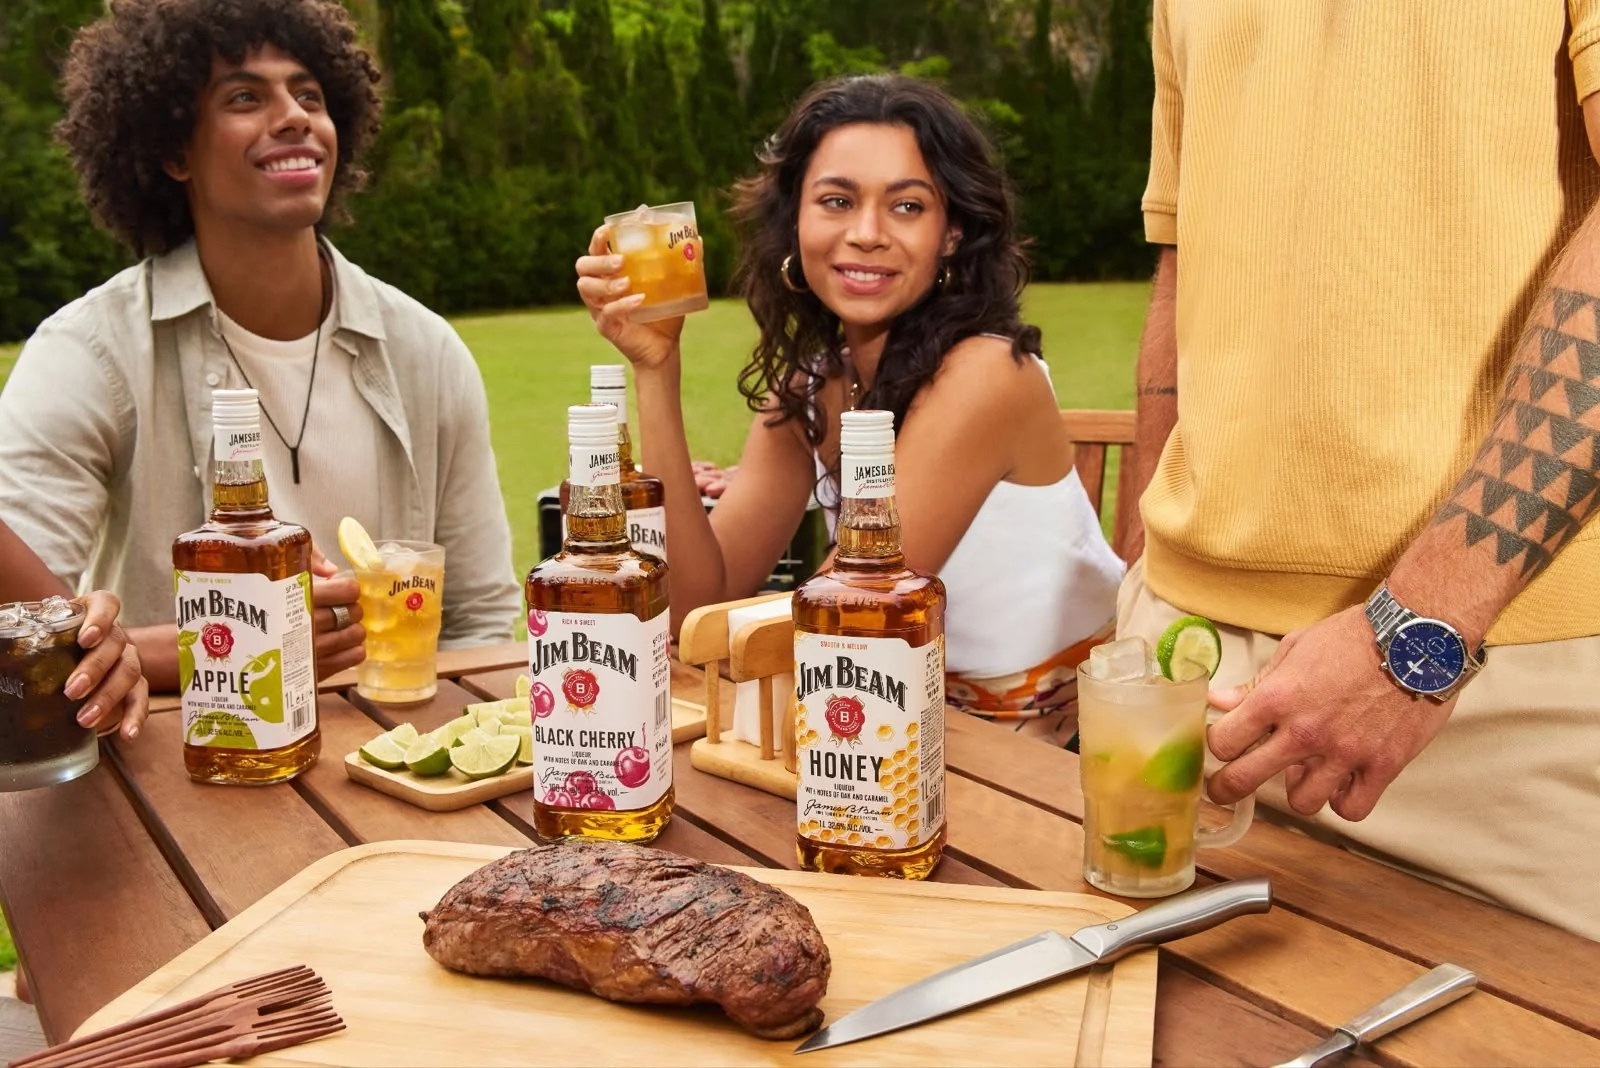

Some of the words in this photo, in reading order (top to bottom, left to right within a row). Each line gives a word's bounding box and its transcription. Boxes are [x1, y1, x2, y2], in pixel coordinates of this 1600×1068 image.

[668, 230, 684, 249] JIM
[229, 433, 252, 446] JAMES
[589, 453, 612, 468] JAMES
[854, 465, 880, 480] JAMES
[630, 523, 665, 552] BEAM
[388, 580, 410, 597] JIM
[412, 575, 435, 594] BEAM
[177, 596, 206, 629] JIM
[208, 589, 268, 634] BEAM
[213, 635, 221, 646] B
[532, 639, 569, 677] JIM
[572, 632, 637, 682] BEAM
[191, 669, 250, 694] APPLE
[576, 683, 585, 694] B
[797, 661, 833, 702] JIM
[836, 655, 906, 712] BEAM
[840, 711, 849, 723] B
[535, 725, 575, 748] BLACK
[579, 730, 635, 749] CHERRY
[809, 749, 884, 783] HONEY
[607, 788, 619, 797] vol.
[816, 789, 832, 797] NOTES
[852, 793, 863, 801] AND
[864, 794, 889, 803] CARAMEL
[834, 783, 855, 792] LIQUEUR
[921, 779, 928, 802] 1L
